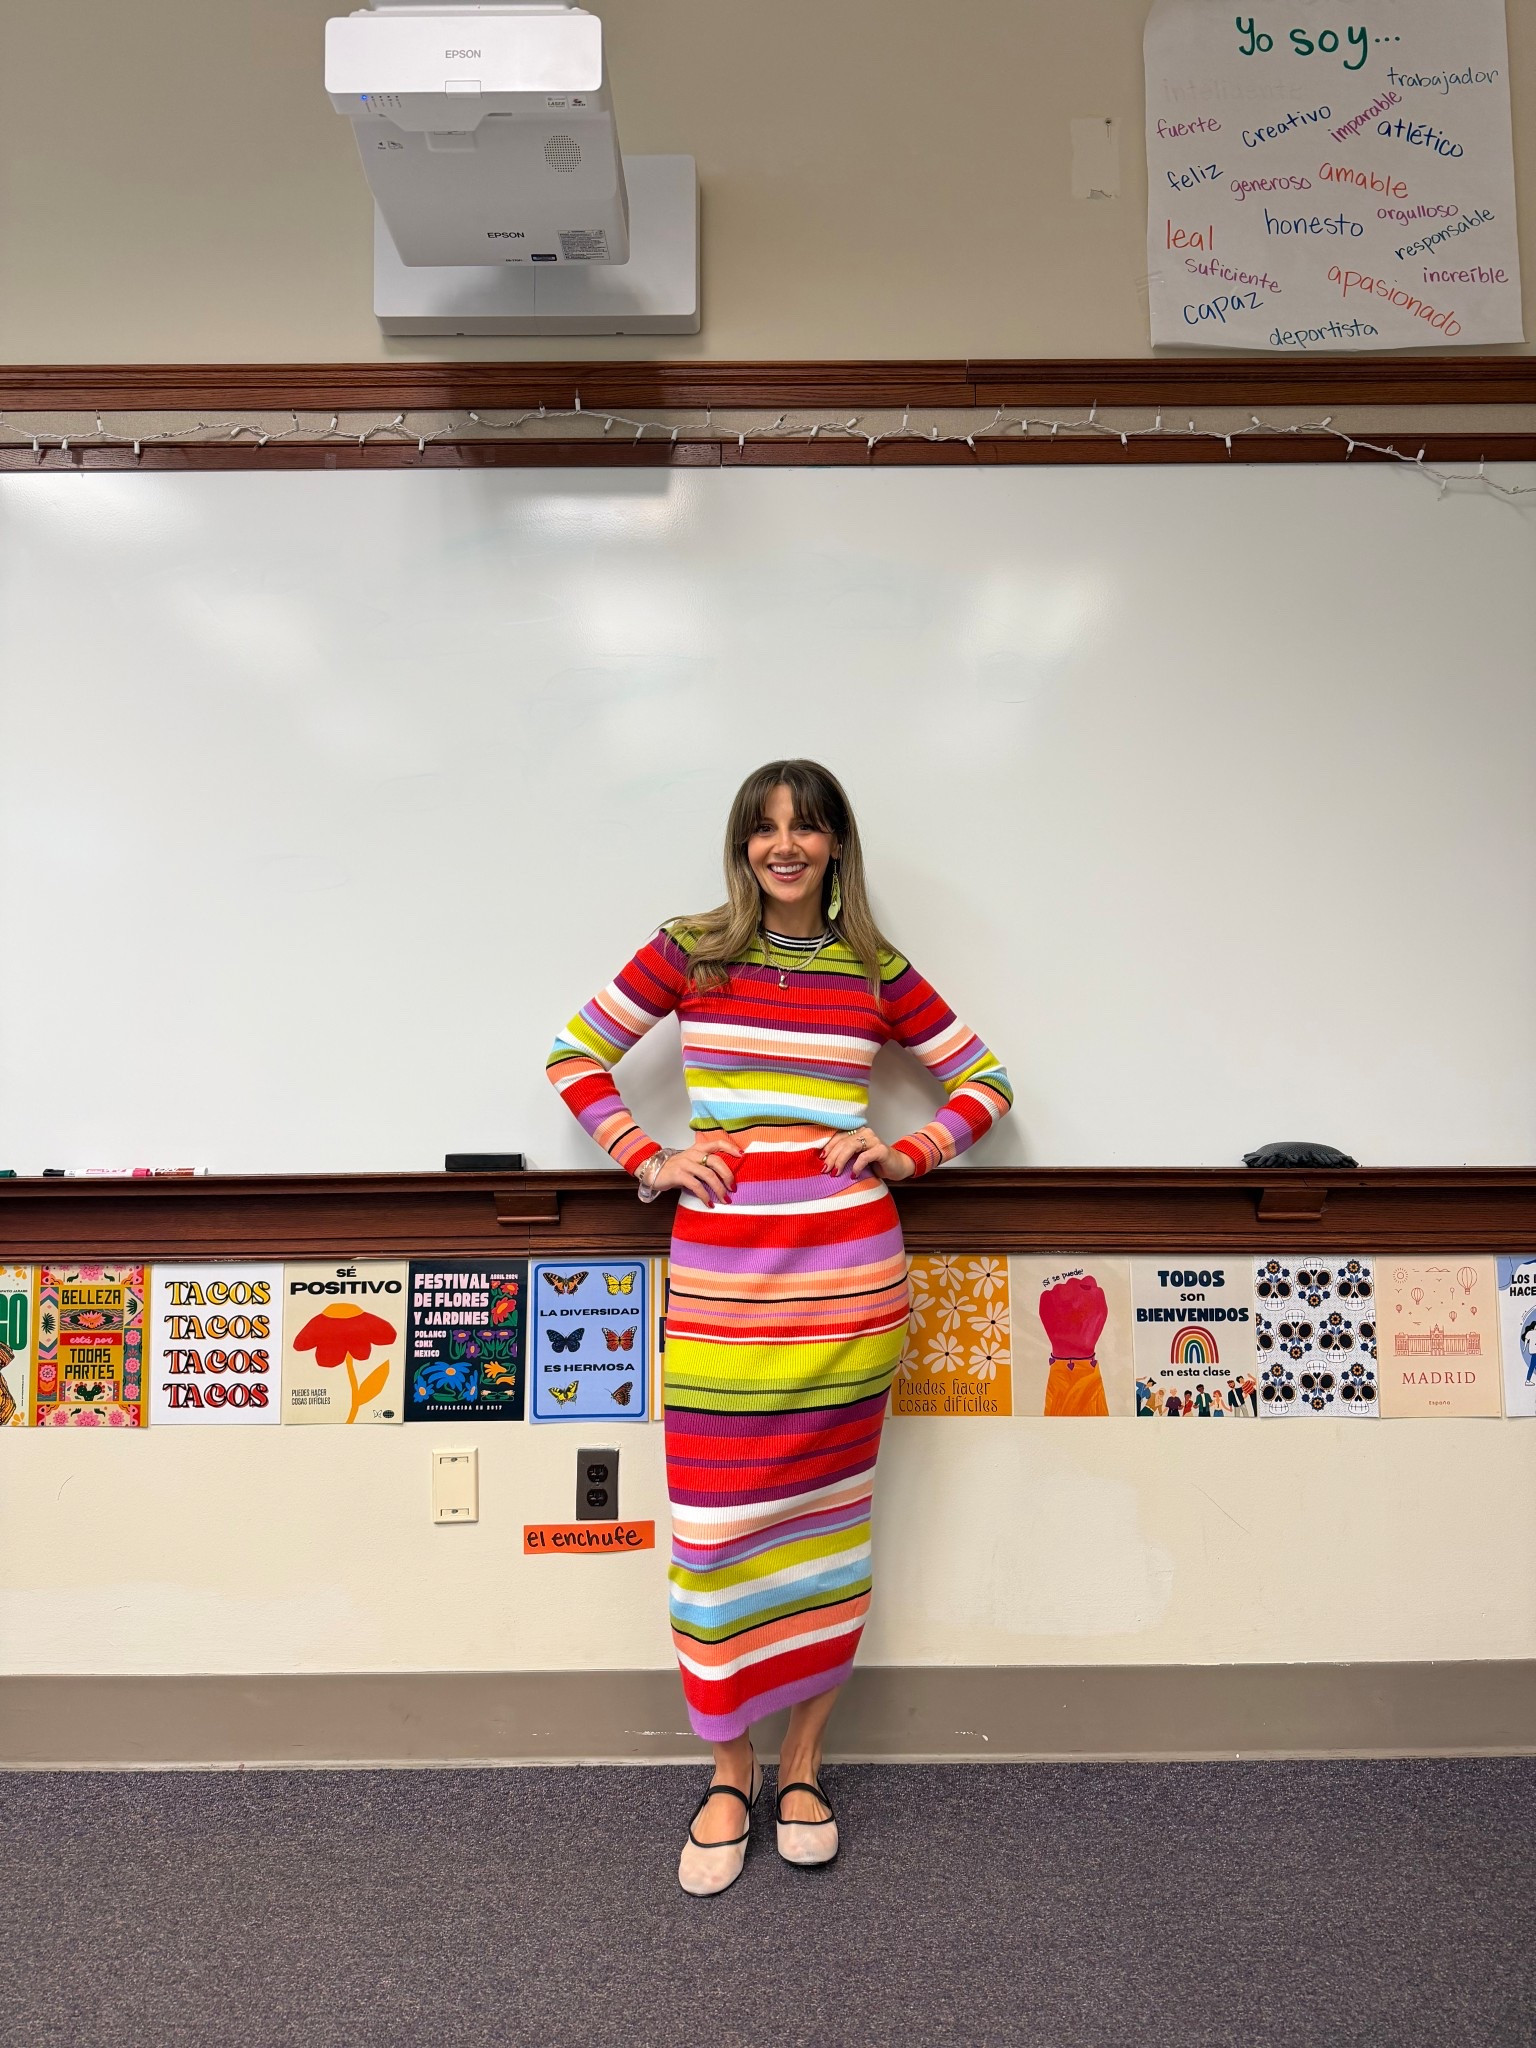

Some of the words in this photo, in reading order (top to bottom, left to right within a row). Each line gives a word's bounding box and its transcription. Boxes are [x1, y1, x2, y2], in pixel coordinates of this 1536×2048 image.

[445, 49, 481, 59] EPSON
[1387, 67, 1499, 95] trabajador
[1328, 90, 1402, 143] imparable
[1157, 116, 1222, 139] fuerte
[1242, 105, 1332, 148] creativo
[1377, 119, 1464, 158] atlético
[1167, 163, 1223, 192] feliz
[1319, 163, 1408, 199] amable
[1230, 176, 1312, 201] generoso
[1265, 208, 1363, 237] honesto
[1377, 204, 1458, 226] orgulloso
[1166, 220, 1213, 251] leal
[1395, 207, 1495, 261] responsable
[1185, 258, 1282, 293] suficiente
[1423, 267, 1509, 284] increíble
[1183, 291, 1264, 325] capaz
[1328, 265, 1461, 337] apasionado
[1270, 319, 1378, 348] deportista
[336, 1266, 356, 1277] SÉ
[1158, 1270, 1225, 1287] TODOS
[1511, 1274, 1530, 1284] LOS
[290, 1280, 401, 1295] POSITIVO
[414, 1274, 489, 1289] FESTIVAL
[62, 1289, 121, 1305] BELLEZA
[165, 1281, 271, 1305] TACOS
[414, 1293, 432, 1307] DE
[435, 1293, 489, 1307] FLORES
[1180, 1293, 1205, 1301] son
[414, 1312, 421, 1325] Y
[425, 1312, 489, 1325] JARDINES
[540, 1309, 556, 1317] LA
[560, 1308, 639, 1316] DIVERSIDAD
[1137, 1308, 1249, 1322] BIENVENIDOS
[164, 1315, 270, 1339] TACOS
[414, 1330, 446, 1338] POLANCO
[70, 1337, 91, 1345] está
[94, 1337, 113, 1346] por
[70, 1348, 111, 1363] TODAS
[163, 1349, 270, 1374] TACOS
[64, 1365, 114, 1380] PARTES
[565, 1363, 635, 1372] HERMOSA
[1177, 1368, 1200, 1376] esta
[1203, 1366, 1230, 1376] clase
[1402, 1372, 1476, 1384] MADRID
[162, 1383, 269, 1408] TACOS
[898, 1379, 946, 1395] Puedes
[953, 1379, 990, 1395] hacer
[899, 1399, 937, 1412] cosas
[944, 1396, 998, 1412] difíciles
[527, 1531, 545, 1547] el
[552, 1526, 643, 1547] enchufe
